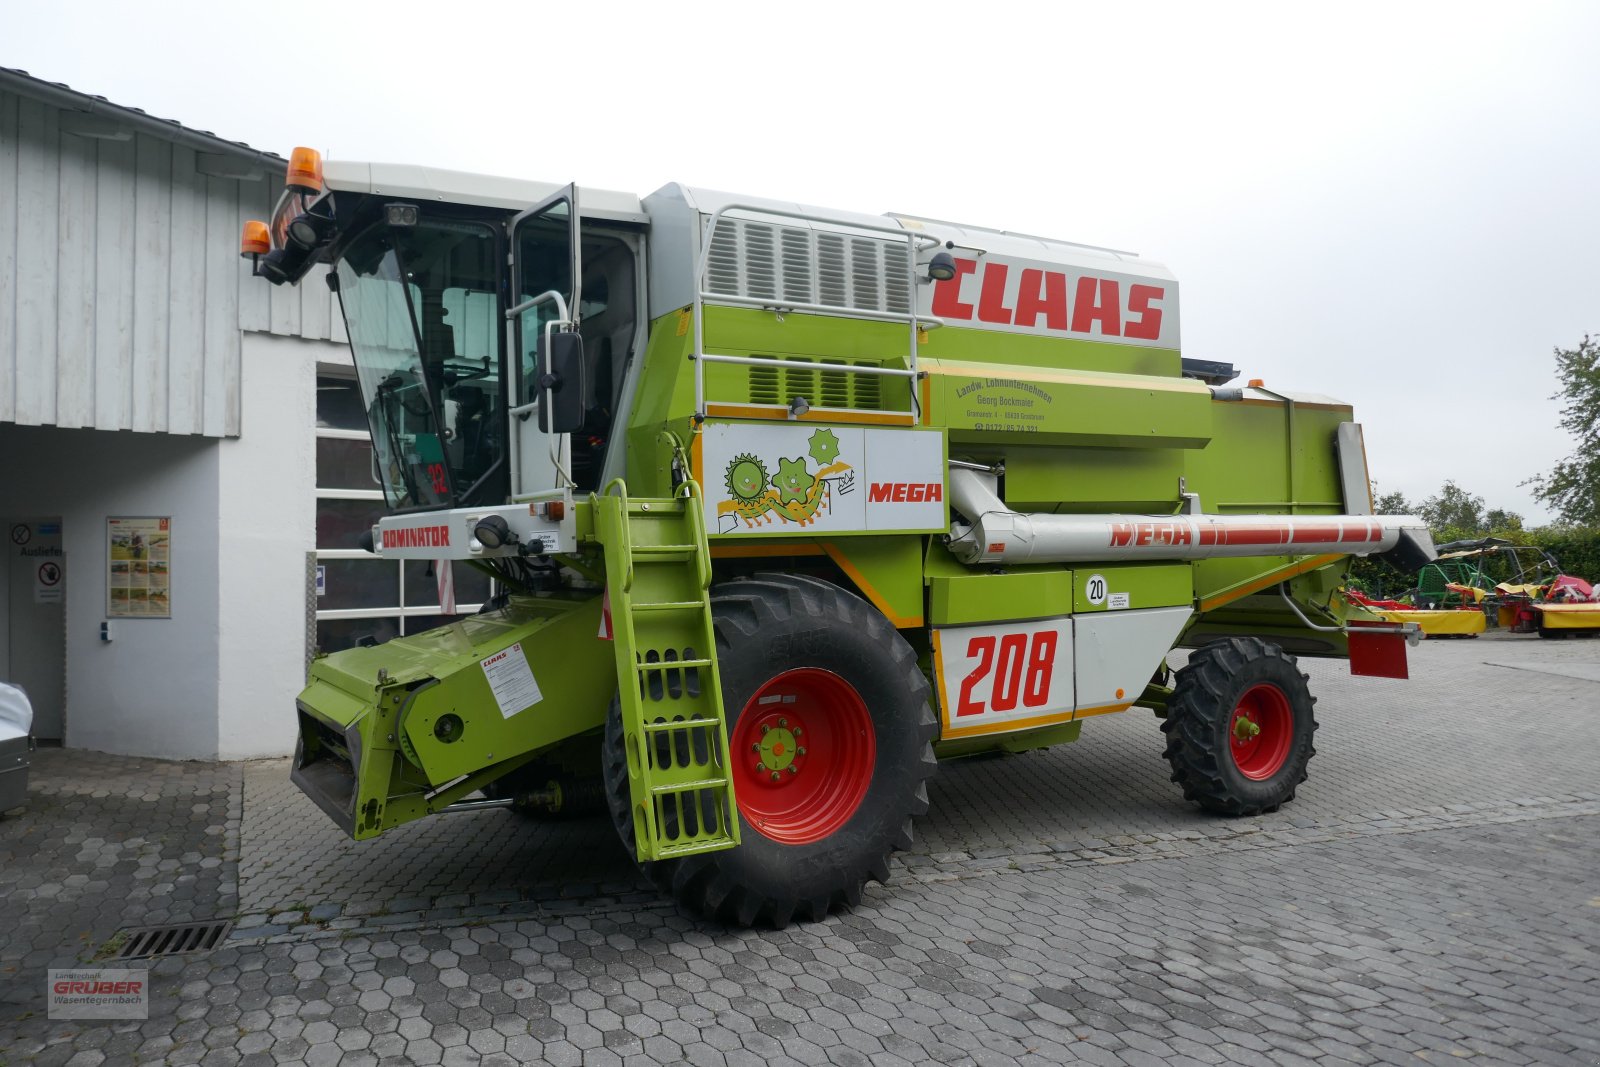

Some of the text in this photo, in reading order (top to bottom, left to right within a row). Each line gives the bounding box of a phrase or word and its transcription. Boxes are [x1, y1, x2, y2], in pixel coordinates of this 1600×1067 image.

[931, 257, 1165, 340] CLAAS
[956, 378, 1052, 404] Landw. Lohnunternehmen
[977, 394, 1034, 407] Georg Bockmaier
[868, 482, 942, 503] MEGA
[383, 525, 450, 549] DOMINATOR
[1109, 523, 1192, 547] MEGA
[1090, 580, 1103, 599] 20
[483, 652, 507, 667] CLAAS
[957, 630, 1058, 717] 208
